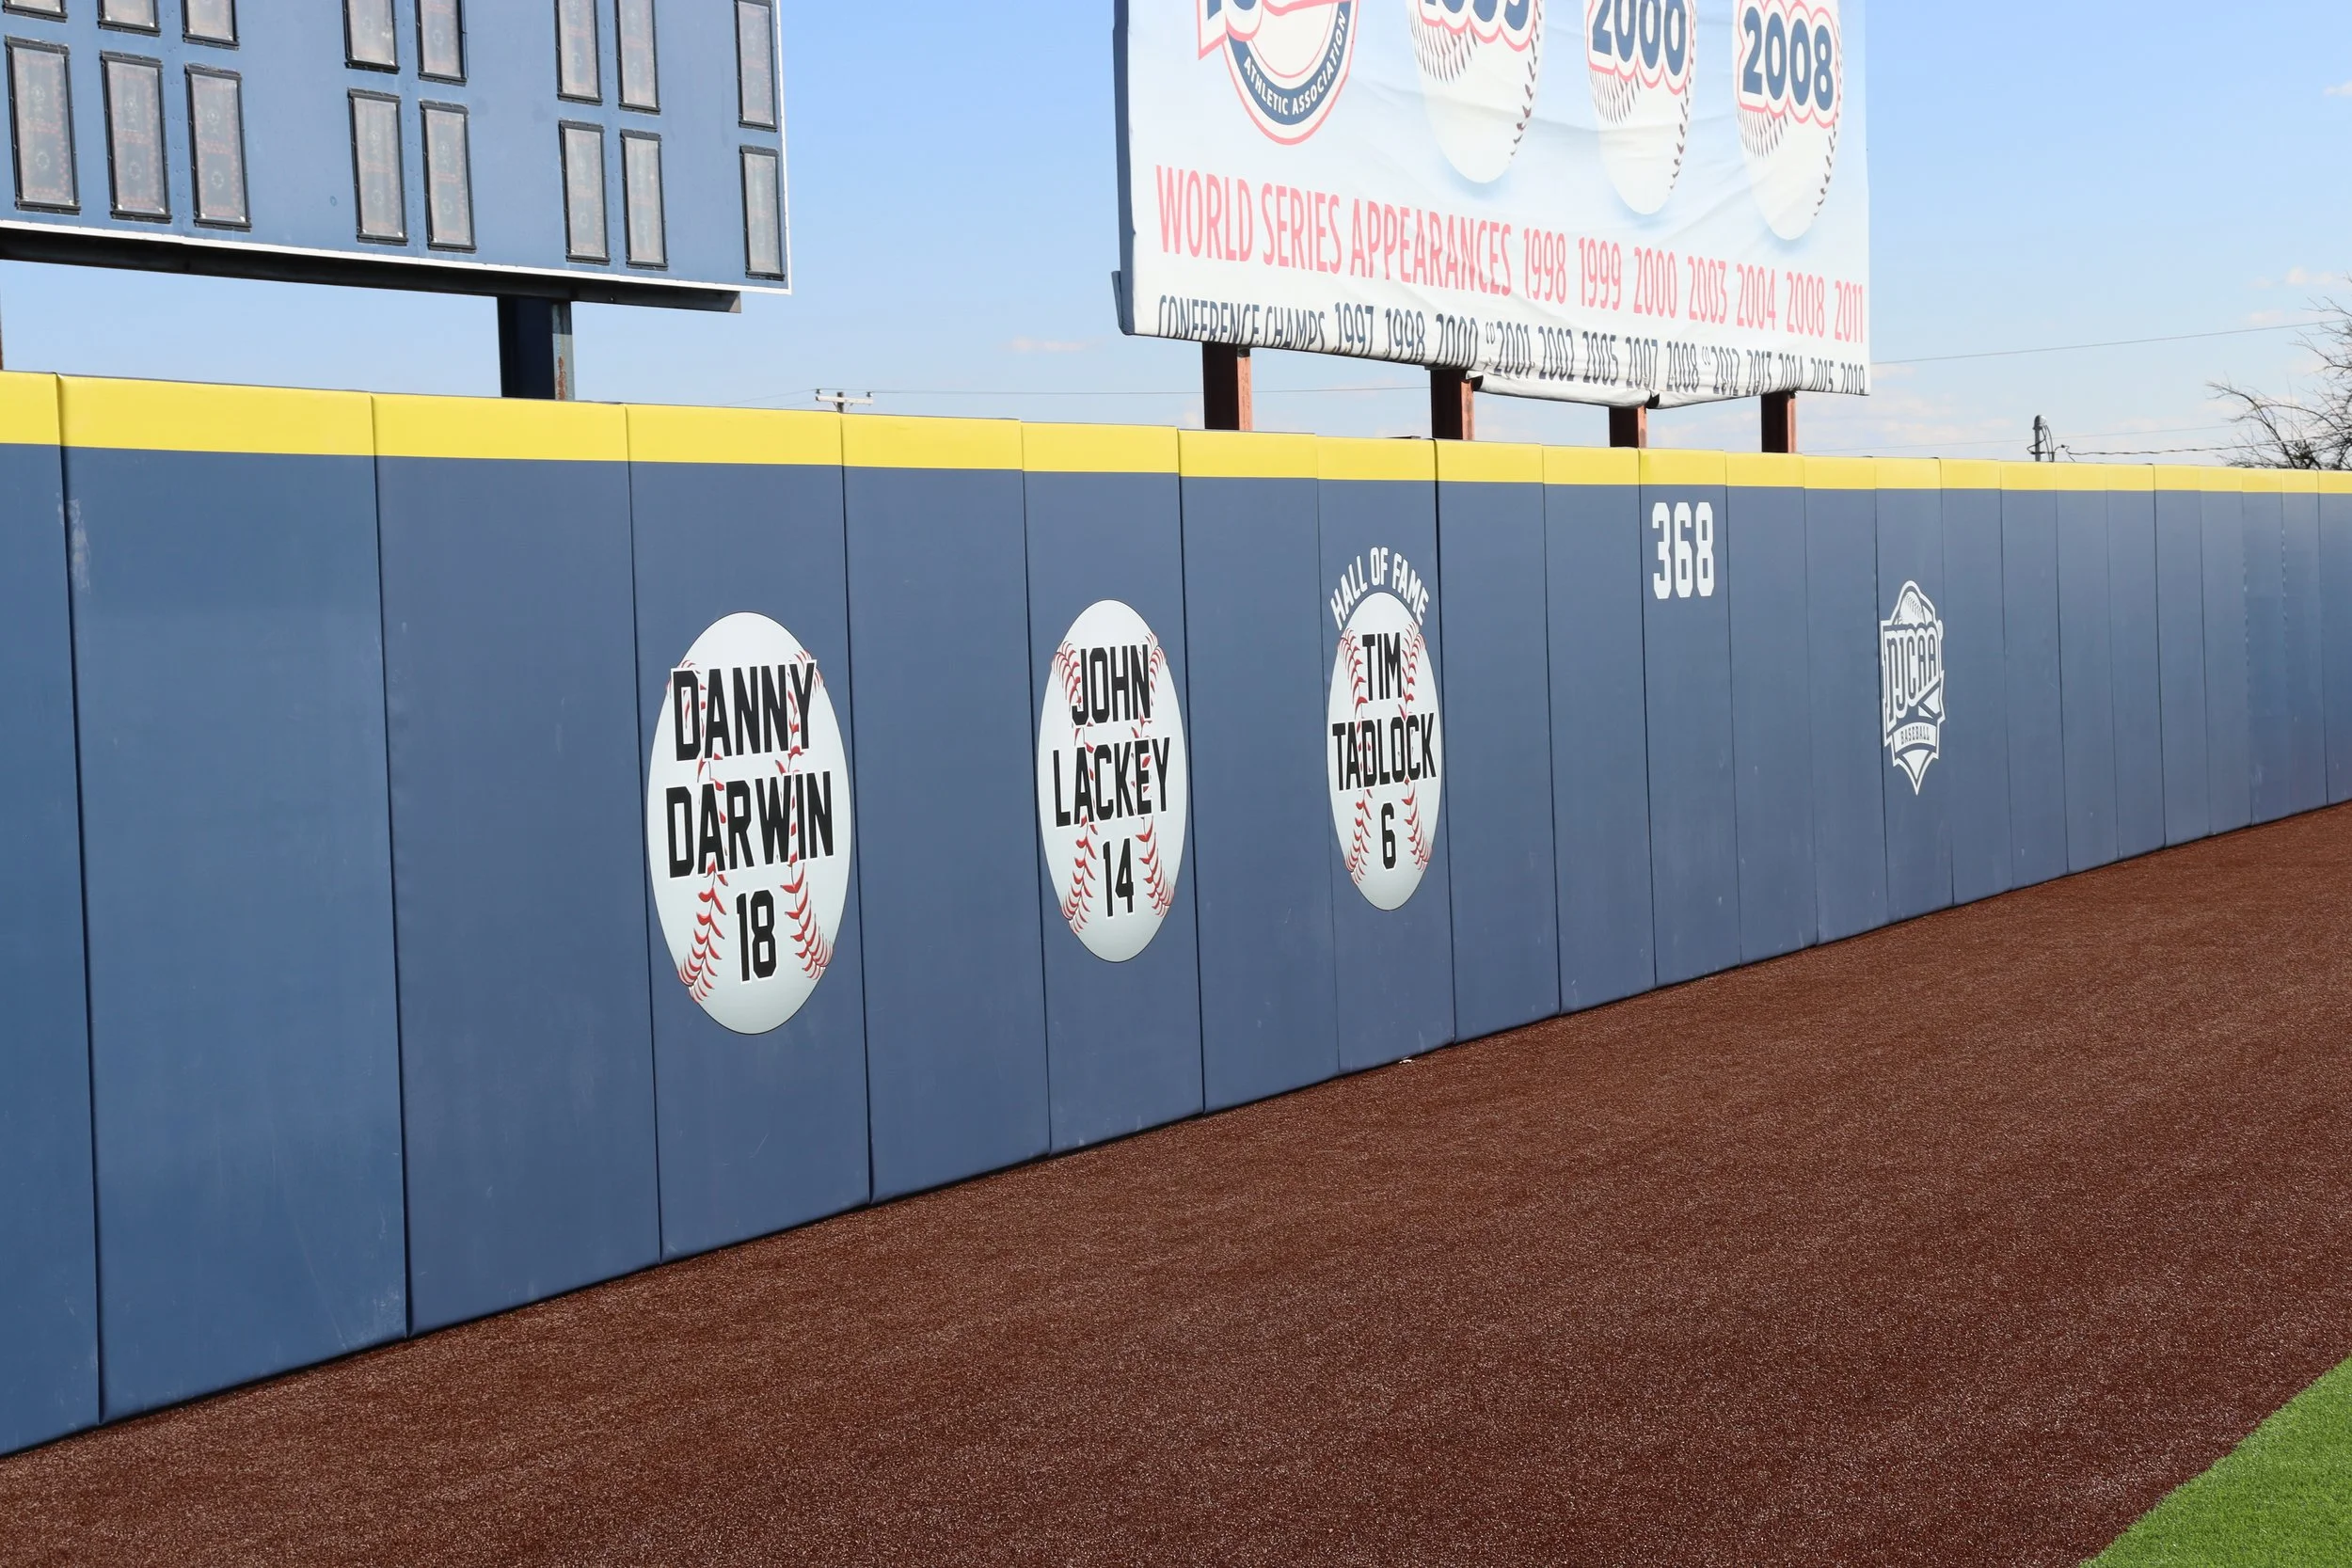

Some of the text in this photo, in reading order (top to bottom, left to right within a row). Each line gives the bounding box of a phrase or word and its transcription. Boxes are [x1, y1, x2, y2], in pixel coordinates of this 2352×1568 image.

[1243, 10, 1346, 116] ATHLETIC ASSOCIATION
[1742, 7, 1834, 111] 2008
[1155, 165, 1864, 343] WORLD SERIES APPEARANCES 1998 1999 2000 2003 2004 2008 2011
[1157, 294, 1260, 346] CONFERENCE
[1263, 305, 1326, 352] CHAMPS
[1332, 301, 1375, 357] 1997
[1384, 308, 1425, 363] 1998
[1434, 313, 1479, 370] 2000
[1494, 320, 1533, 378] 2001
[1538, 325, 1575, 382] 2002
[1582, 330, 1619, 387] 2005
[1625, 336, 1659, 391] 2007
[1666, 340, 1700, 393] 2008
[1710, 344, 1740, 397] 2012
[1329, 546, 1430, 631] HALL OF FAME
[1651, 501, 1715, 599] 368
[671, 659, 817, 762] DANNY
[1071, 643, 1152, 727] JOHN
[1361, 632, 1403, 702] TIM
[1884, 626, 1939, 733] NJCAA
[1052, 736, 1171, 828] LACKEY
[1331, 712, 1437, 792] TADLOCK
[1900, 725, 1931, 745] BASEBALL
[664, 769, 834, 879] DARWIN
[1380, 800, 1397, 870] 6
[1102, 837, 1135, 918] 14
[735, 888, 778, 984] 18
